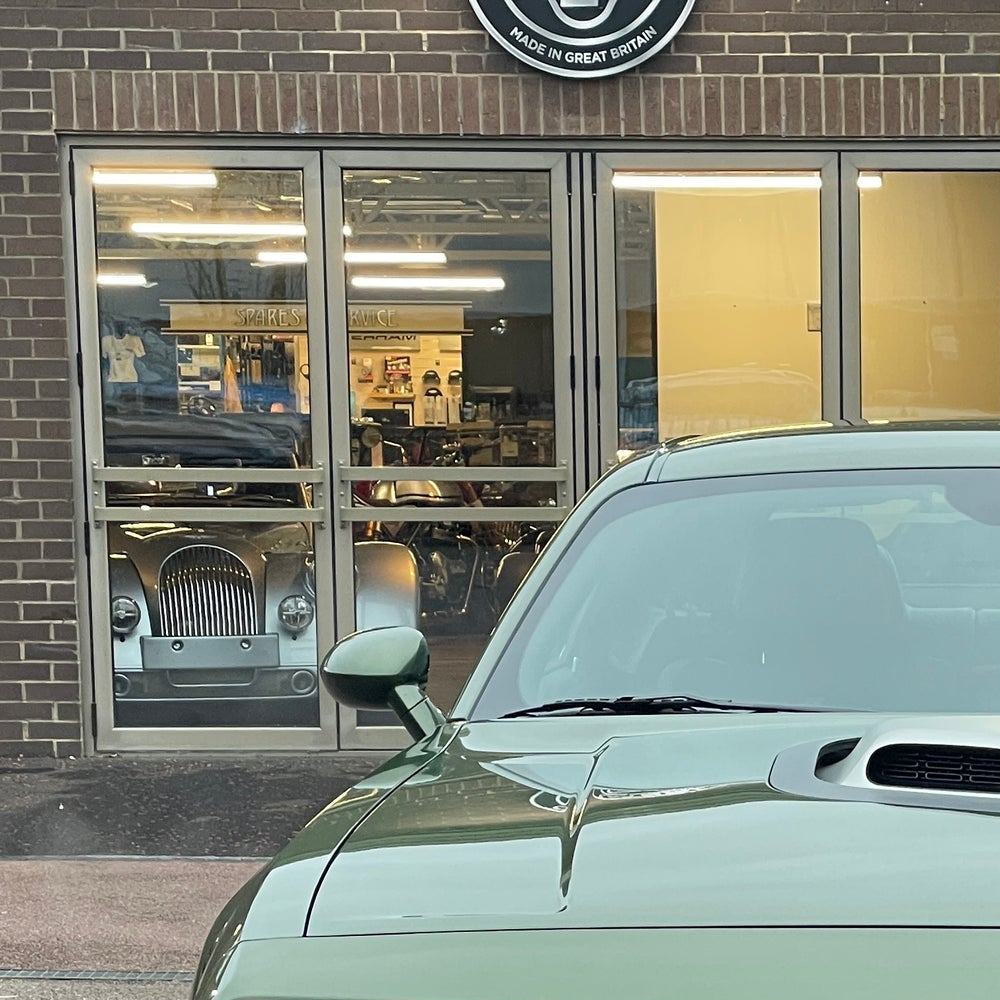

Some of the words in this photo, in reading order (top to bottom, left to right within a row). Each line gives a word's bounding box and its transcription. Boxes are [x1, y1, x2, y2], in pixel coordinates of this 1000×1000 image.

[509, 26, 546, 55] MADE
[547, 46, 562, 61] IN
[564, 51, 608, 65] GREAT
[610, 25, 659, 60] BRITAIN
[236, 307, 302, 327] SPARES
[350, 308, 398, 327] RVICE
